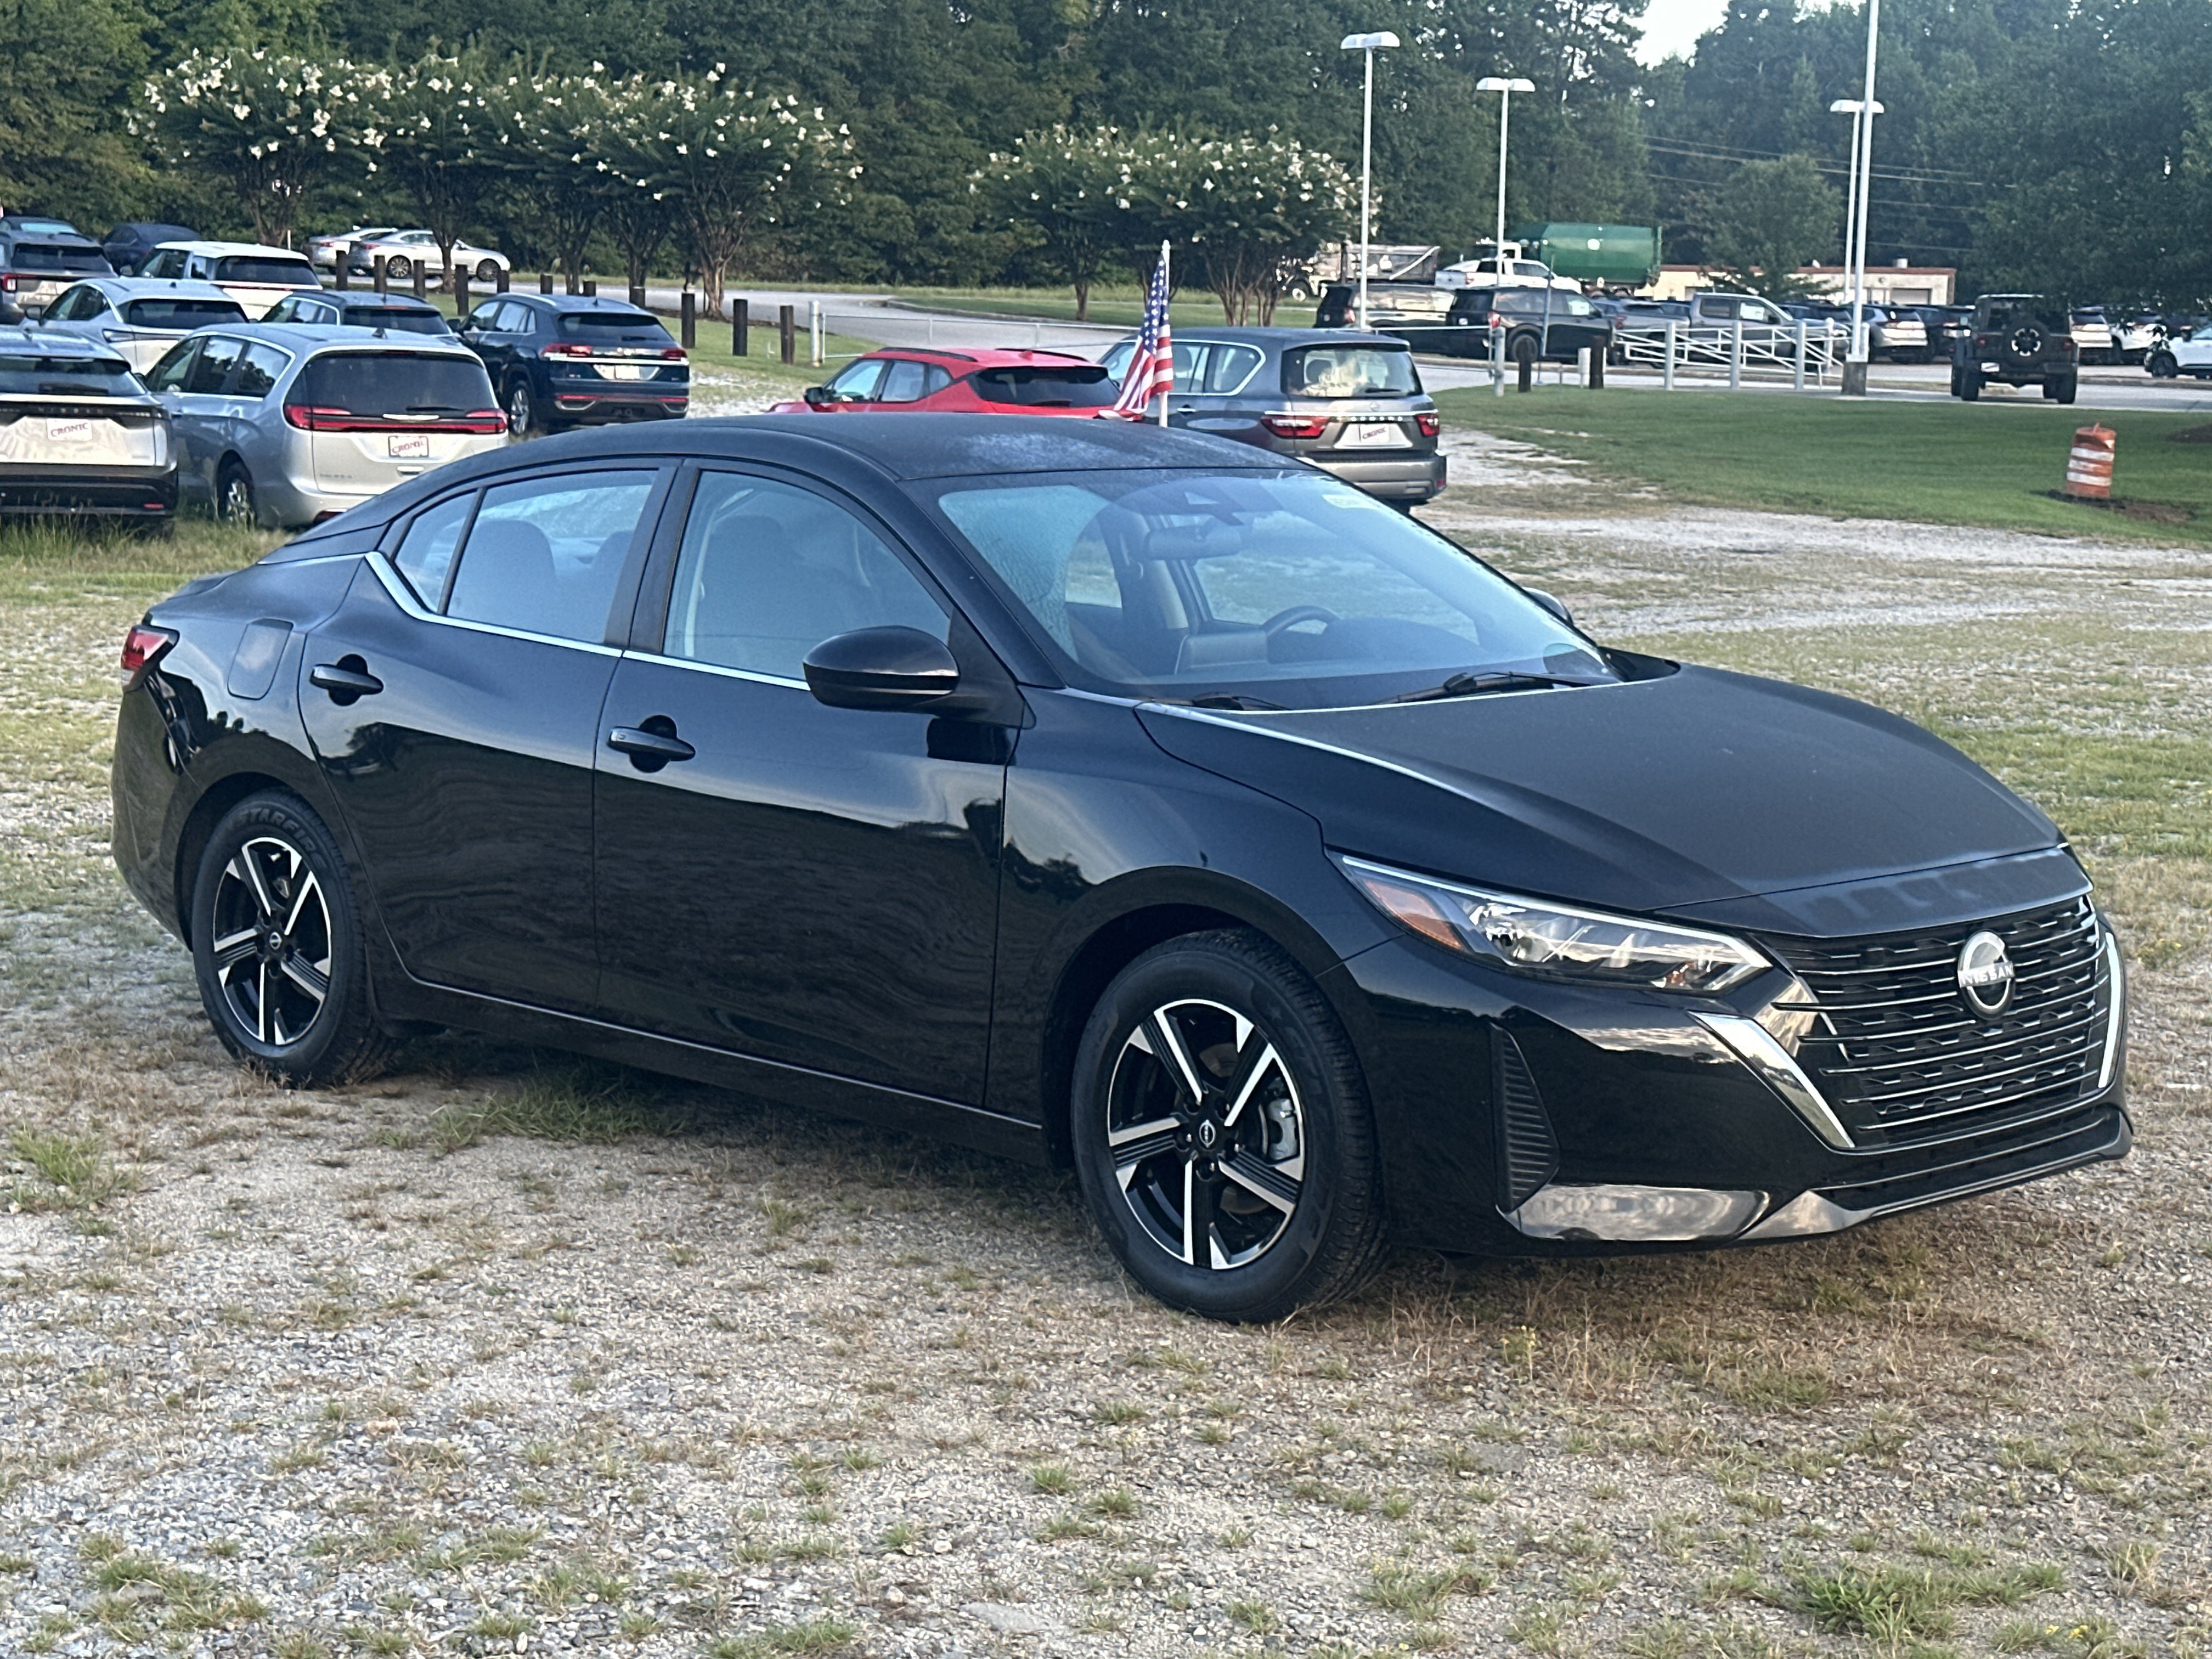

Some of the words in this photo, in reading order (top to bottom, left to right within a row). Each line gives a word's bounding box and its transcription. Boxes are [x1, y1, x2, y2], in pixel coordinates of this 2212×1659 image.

[50, 422, 88, 437] CRONIC
[236, 808, 328, 870] STARFIRE
[1961, 964, 2013, 986] NISSAN
